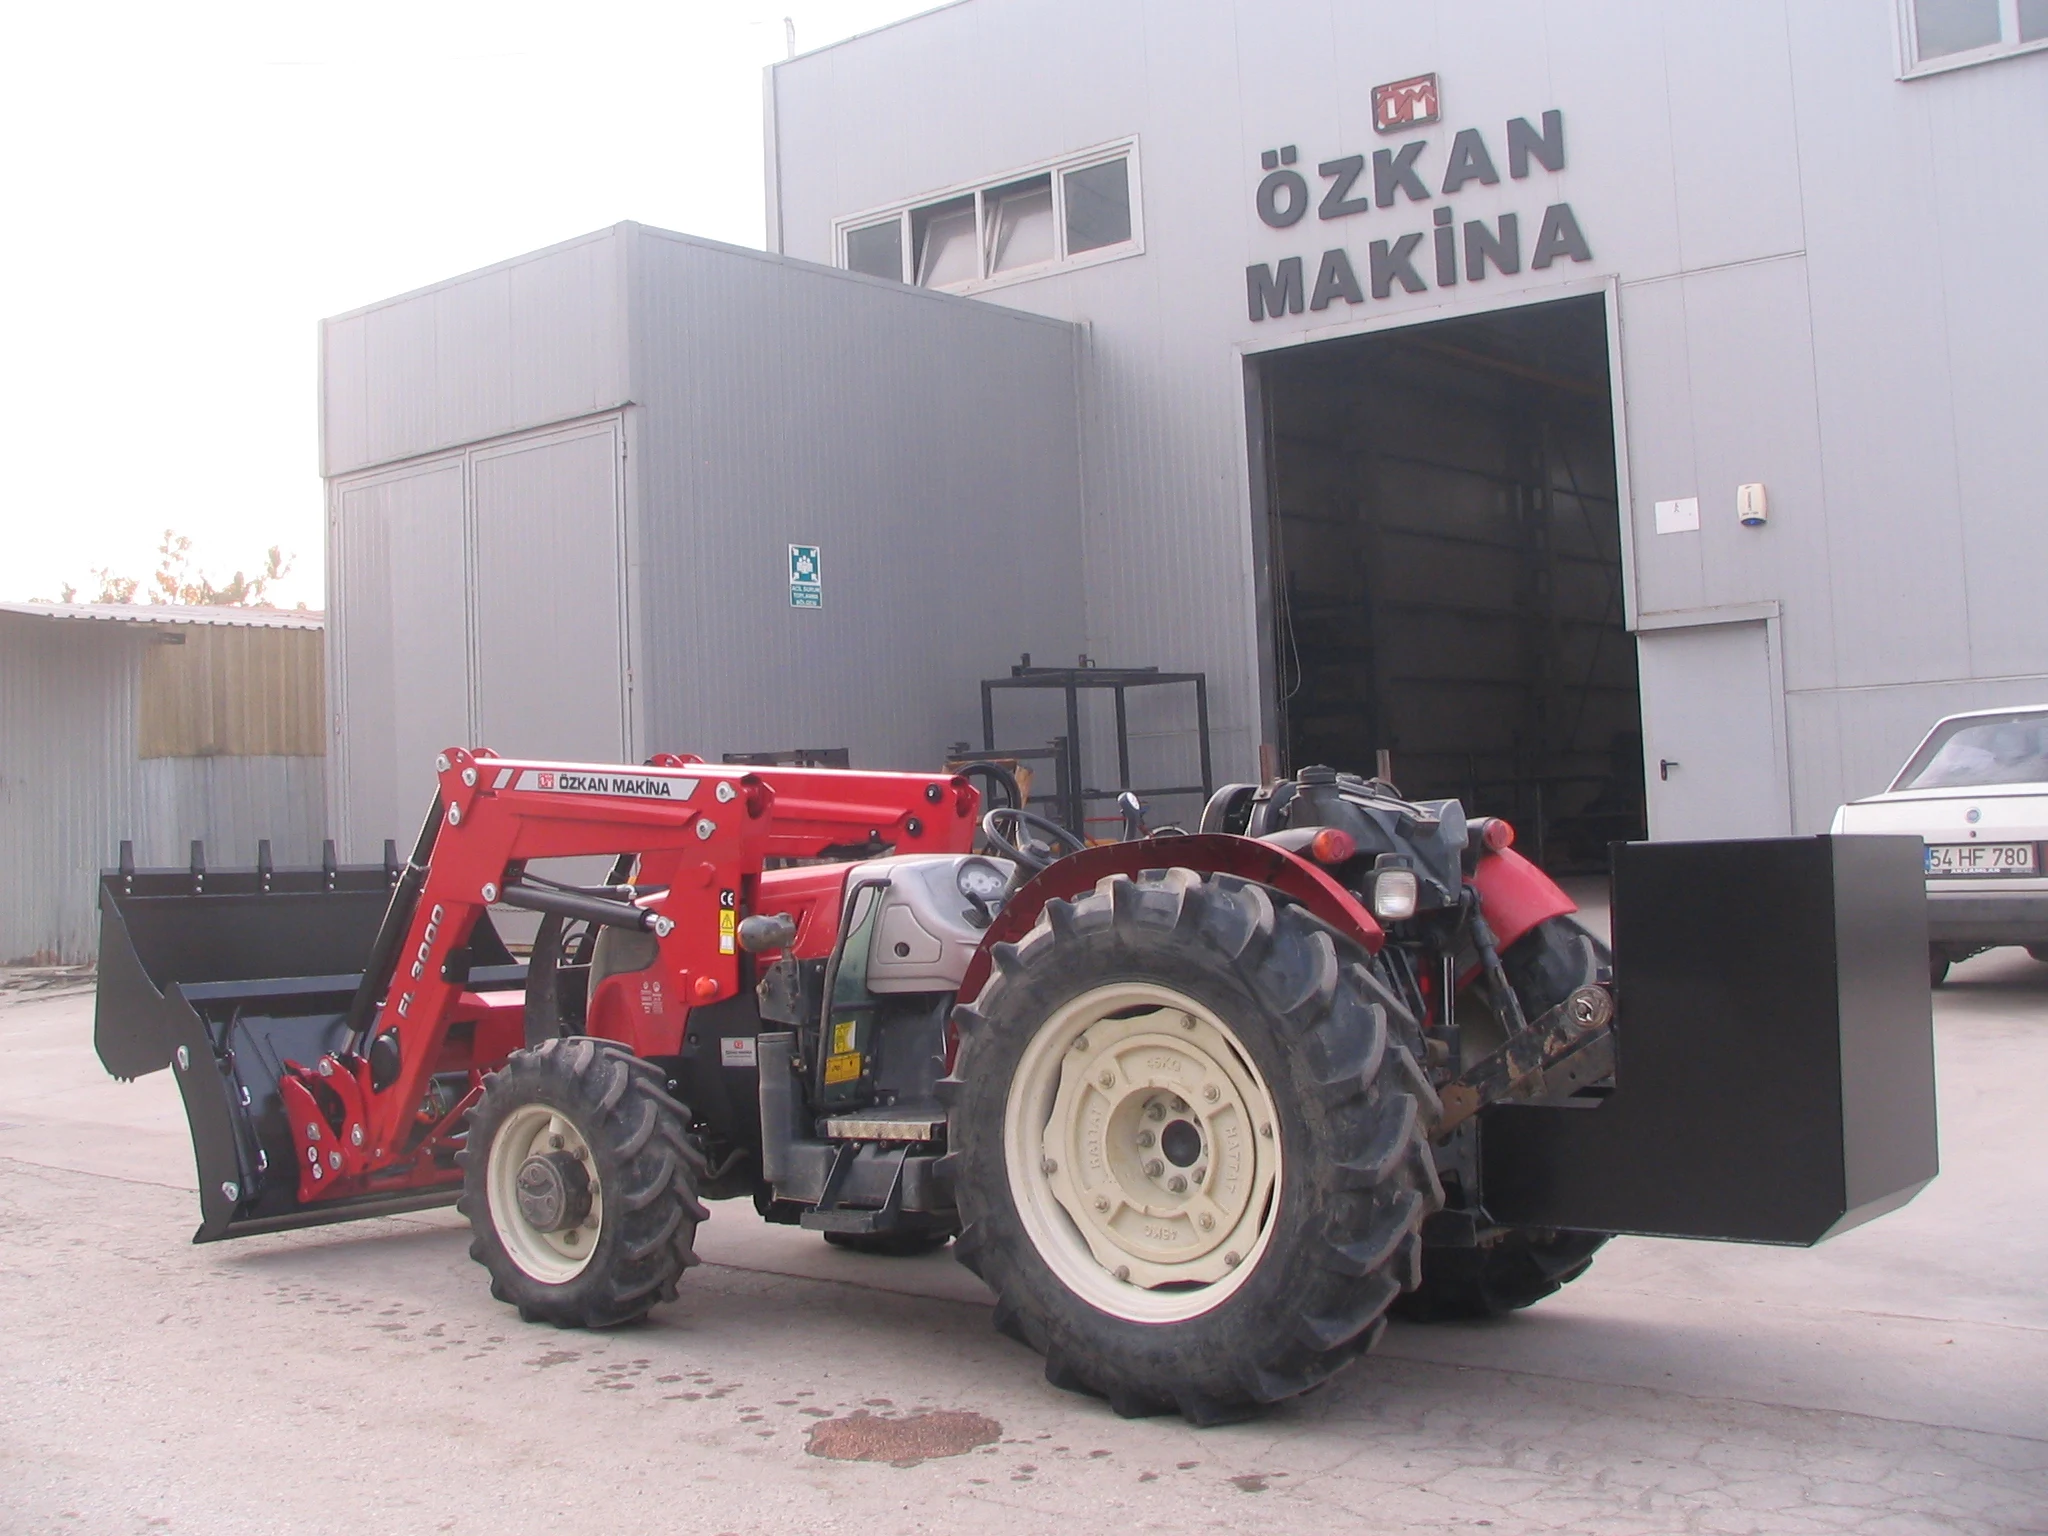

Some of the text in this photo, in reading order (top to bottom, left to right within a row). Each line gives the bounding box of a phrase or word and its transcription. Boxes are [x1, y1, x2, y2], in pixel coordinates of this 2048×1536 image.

[1256, 109, 1565, 229] ÖZKAN
[1246, 202, 1592, 322] MAKİNA
[559, 774, 608, 792] ÖZKAN
[612, 779, 671, 796] MAKİNA
[1931, 847, 2028, 867] 54 HF 780
[411, 903, 444, 981] 3000
